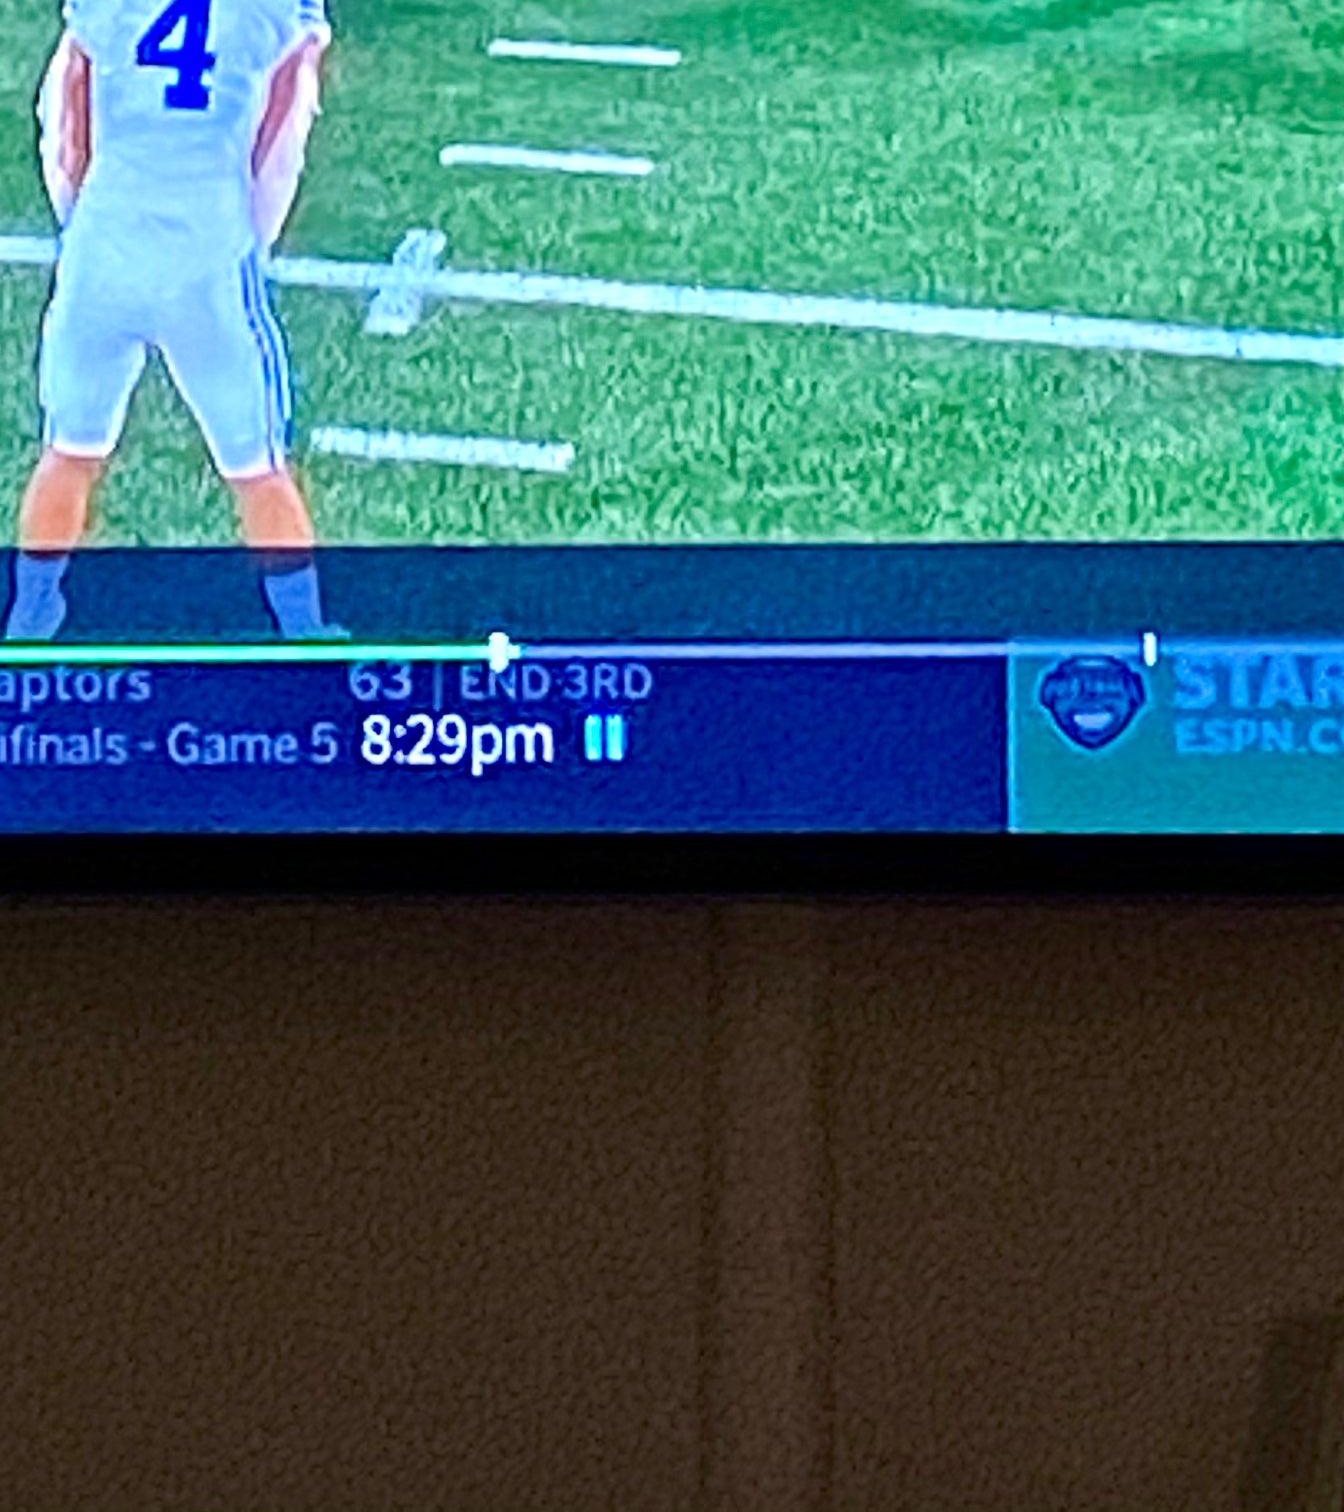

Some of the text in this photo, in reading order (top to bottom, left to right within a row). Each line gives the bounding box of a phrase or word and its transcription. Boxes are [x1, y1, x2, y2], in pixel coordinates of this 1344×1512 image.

[350, 662, 654, 701] 63 END 3RD
[167, 721, 299, 766] Game
[310, 720, 339, 765] 5
[361, 713, 555, 776] 8:29pm
